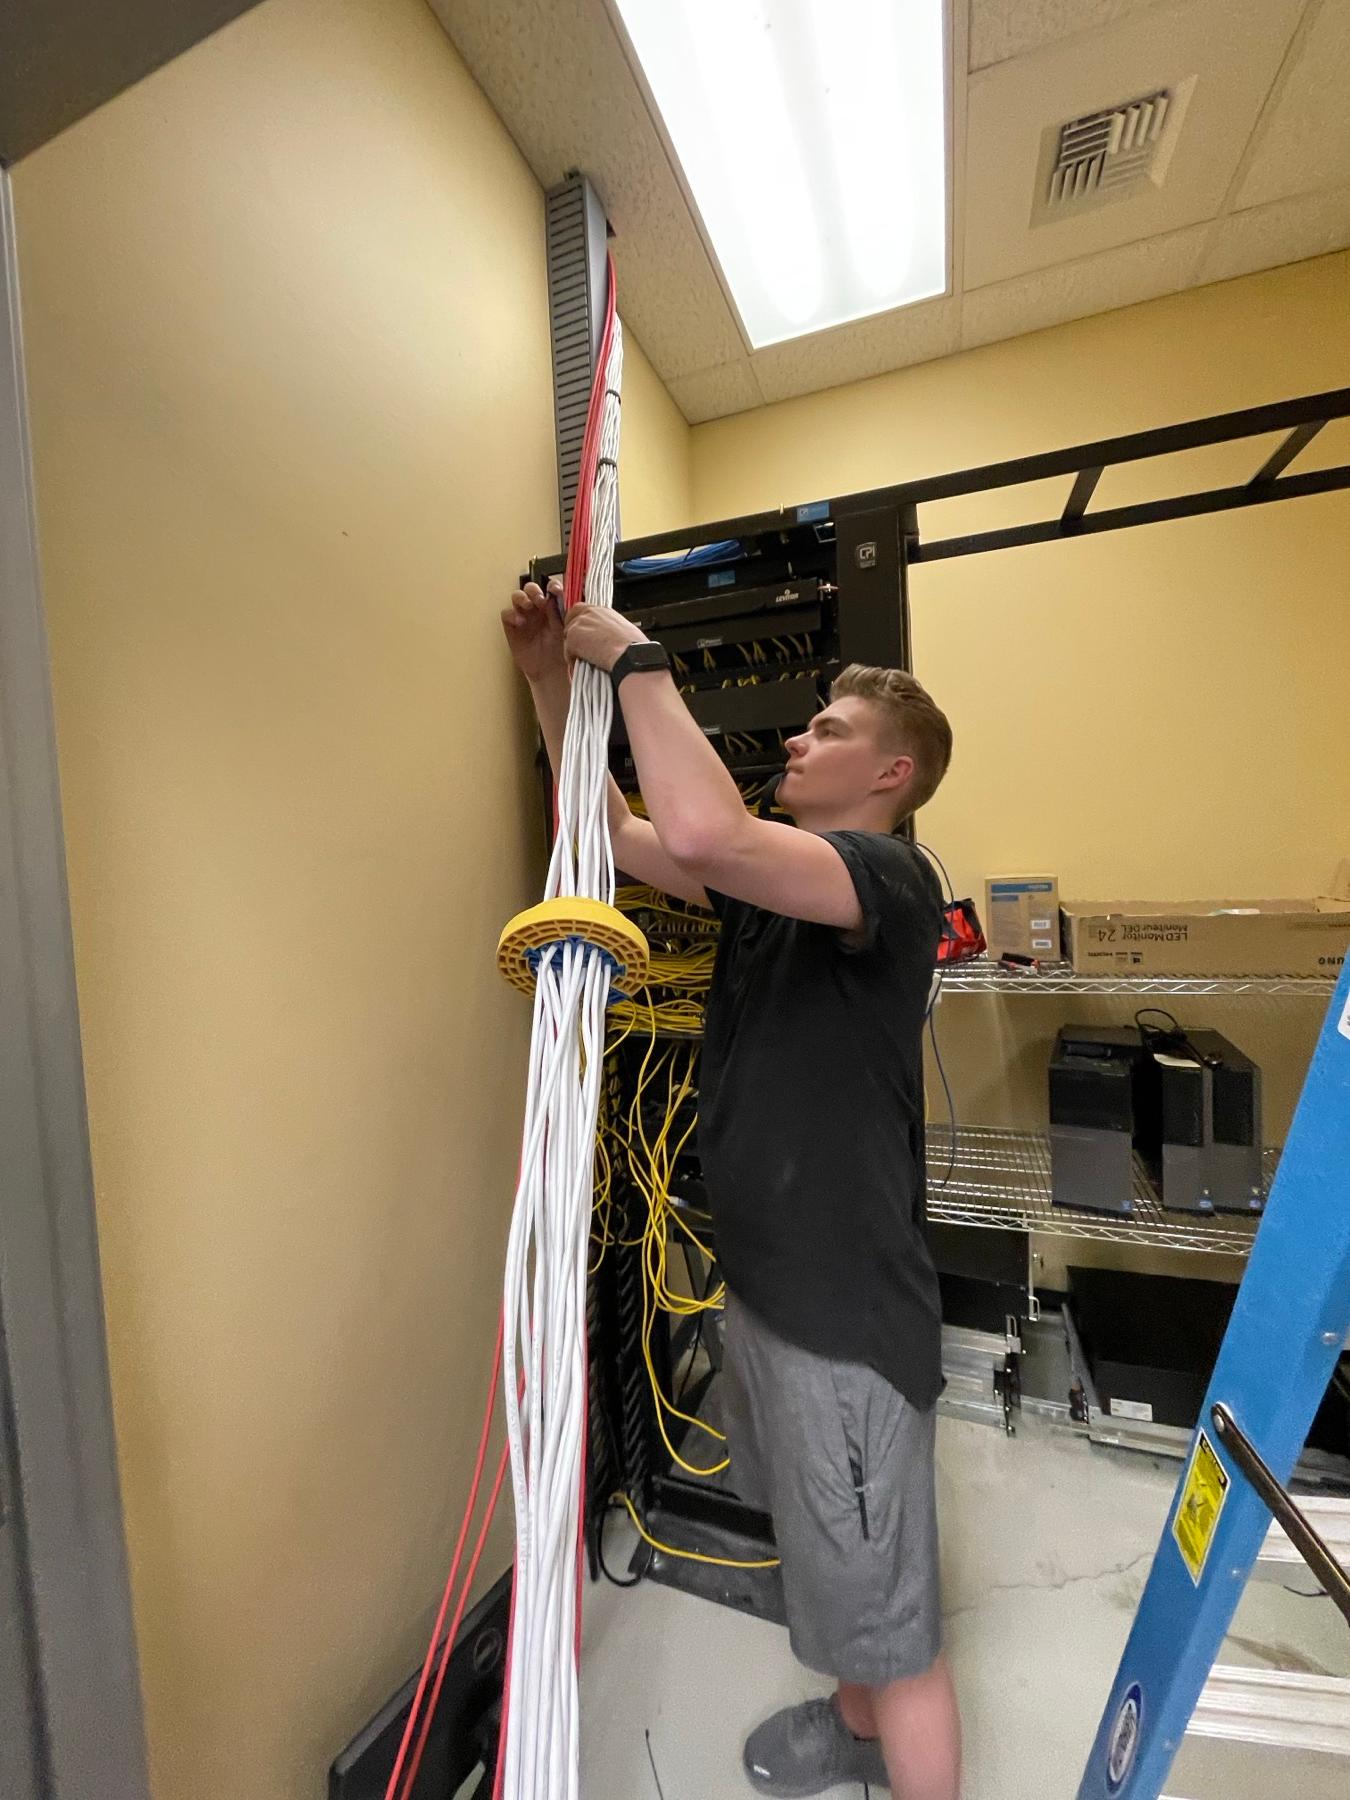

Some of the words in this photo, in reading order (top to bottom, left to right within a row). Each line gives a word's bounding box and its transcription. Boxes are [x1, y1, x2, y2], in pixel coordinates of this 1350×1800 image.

[859, 545, 875, 560] CPI
[1120, 924, 1140, 933] DEL
[1097, 929, 1117, 943] 24
[1121, 932, 1164, 942] Monitor
[1166, 932, 1188, 942] LED
